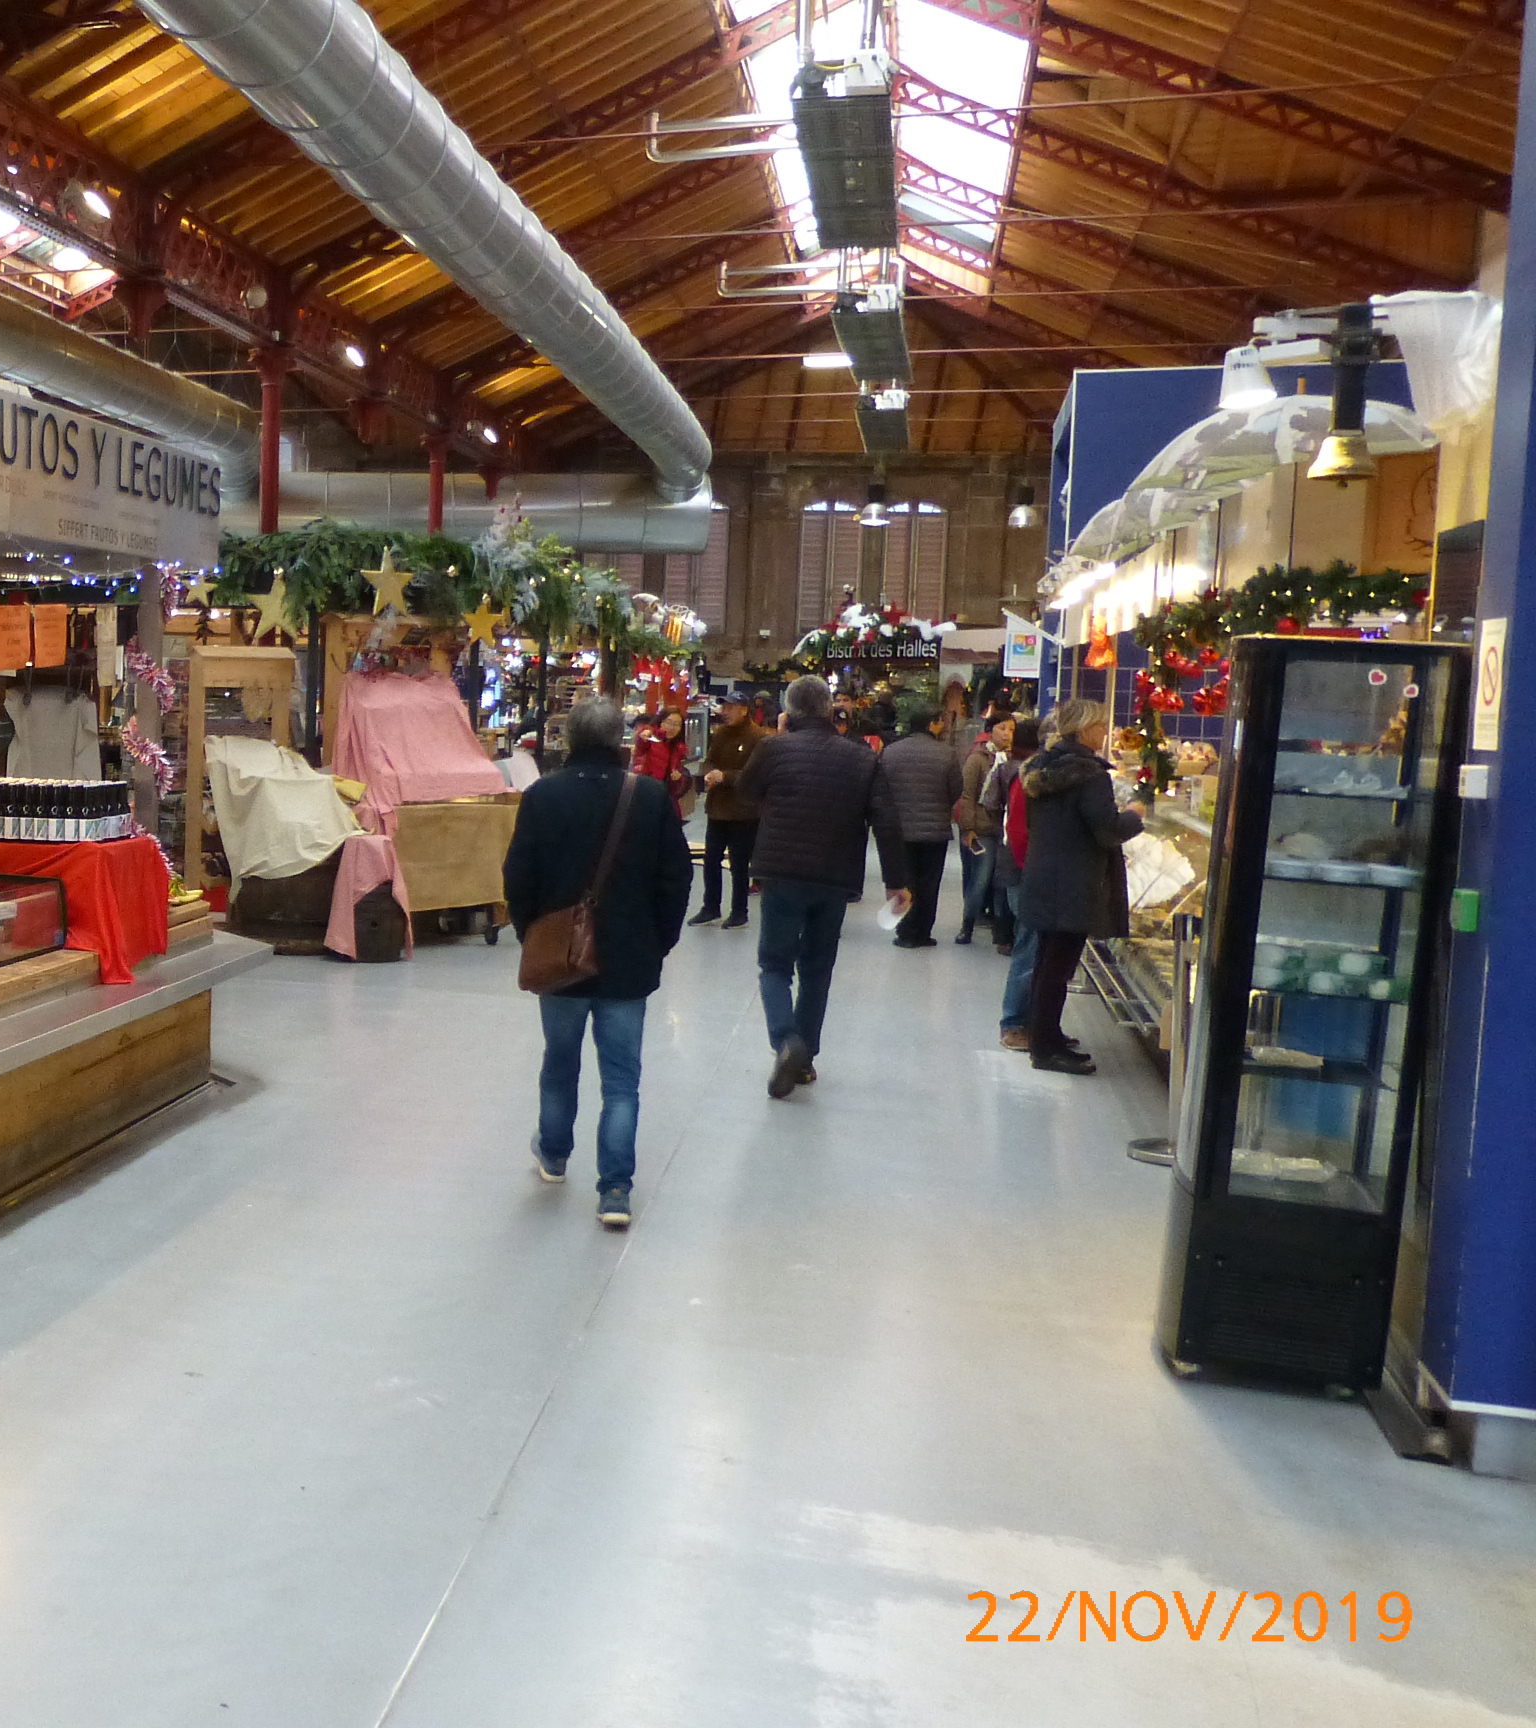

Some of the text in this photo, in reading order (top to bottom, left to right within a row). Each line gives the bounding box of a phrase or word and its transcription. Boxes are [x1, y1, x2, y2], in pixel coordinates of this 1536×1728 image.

[90, 427, 110, 487] Y
[117, 440, 222, 518] LEGUMES
[58, 518, 89, 541] SIFFERT
[90, 525, 119, 547] FRUTOS
[827, 638, 937, 659] Bistrt des Halles
